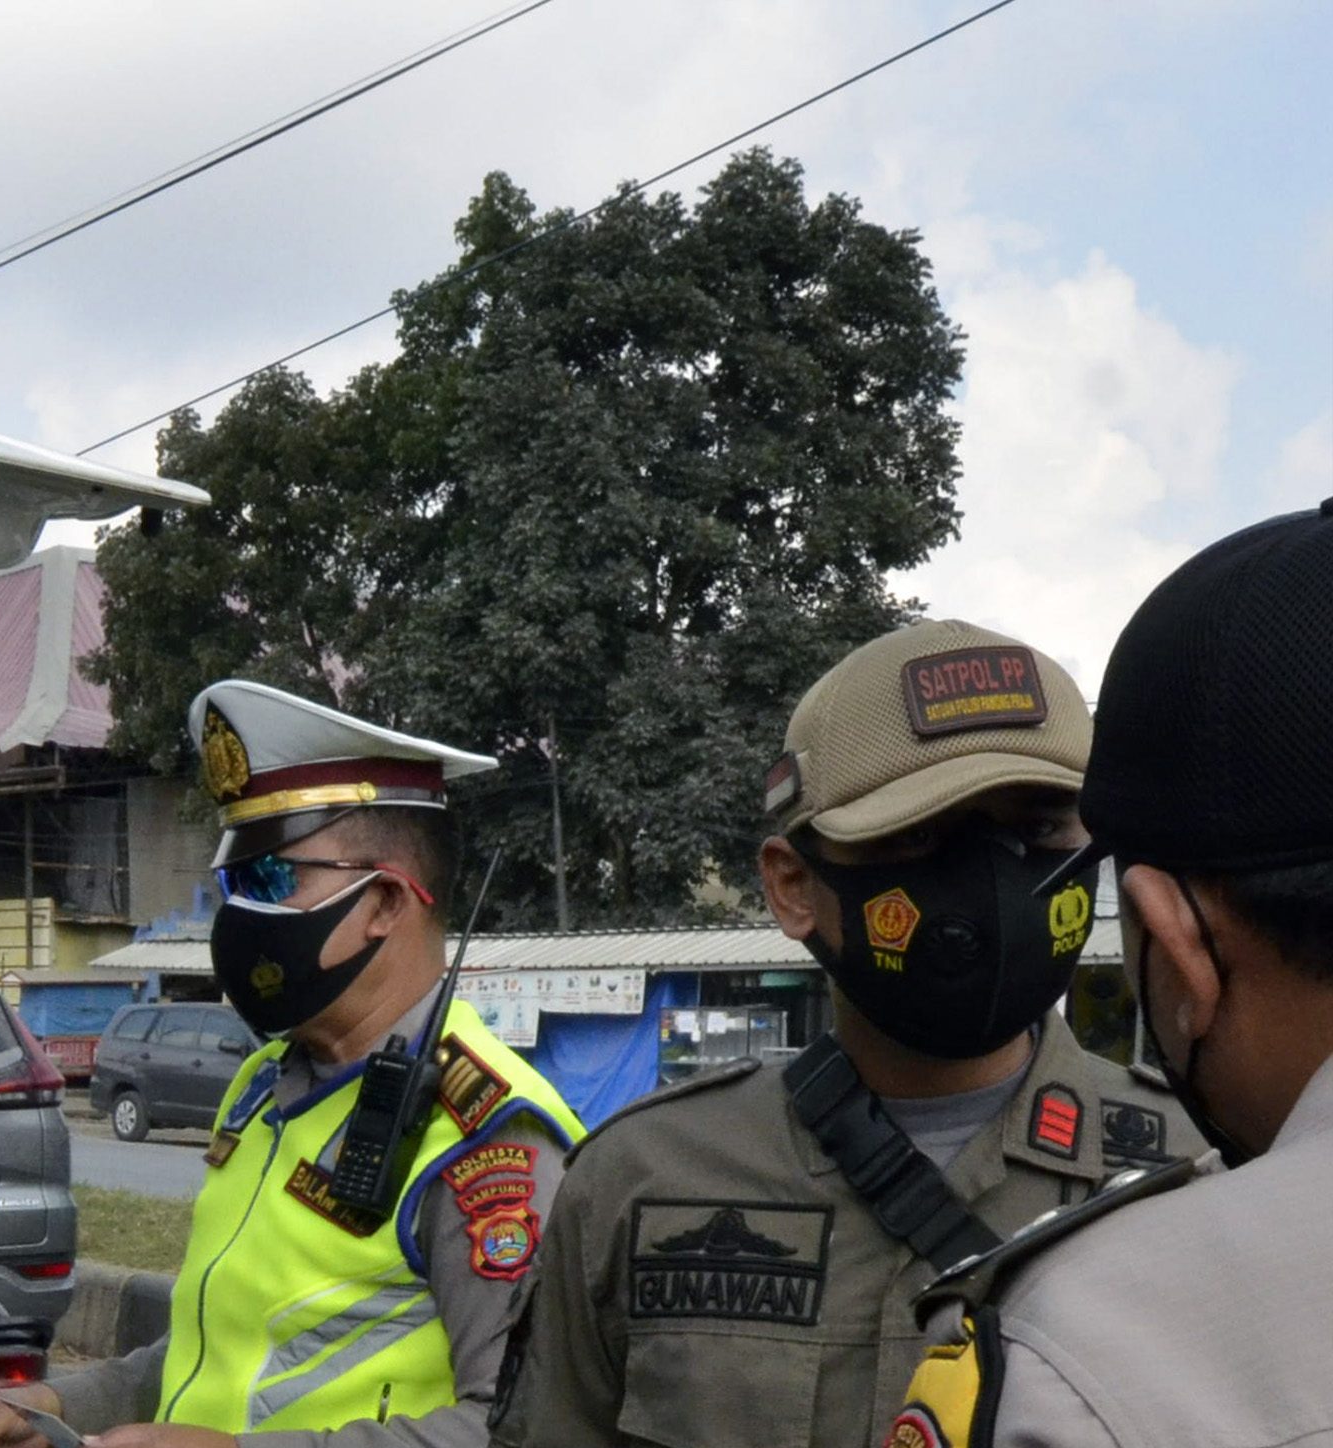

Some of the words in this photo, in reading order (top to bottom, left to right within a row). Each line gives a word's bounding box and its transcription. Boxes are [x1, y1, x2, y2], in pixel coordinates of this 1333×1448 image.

[917, 658, 1000, 701] SATPOL
[1000, 657, 1025, 688] PP
[872, 950, 904, 972] TNI
[452, 1147, 526, 1177] POLRESTA
[464, 1184, 527, 1207] LAMPUNG
[638, 1271, 807, 1317] GUNAWAN
